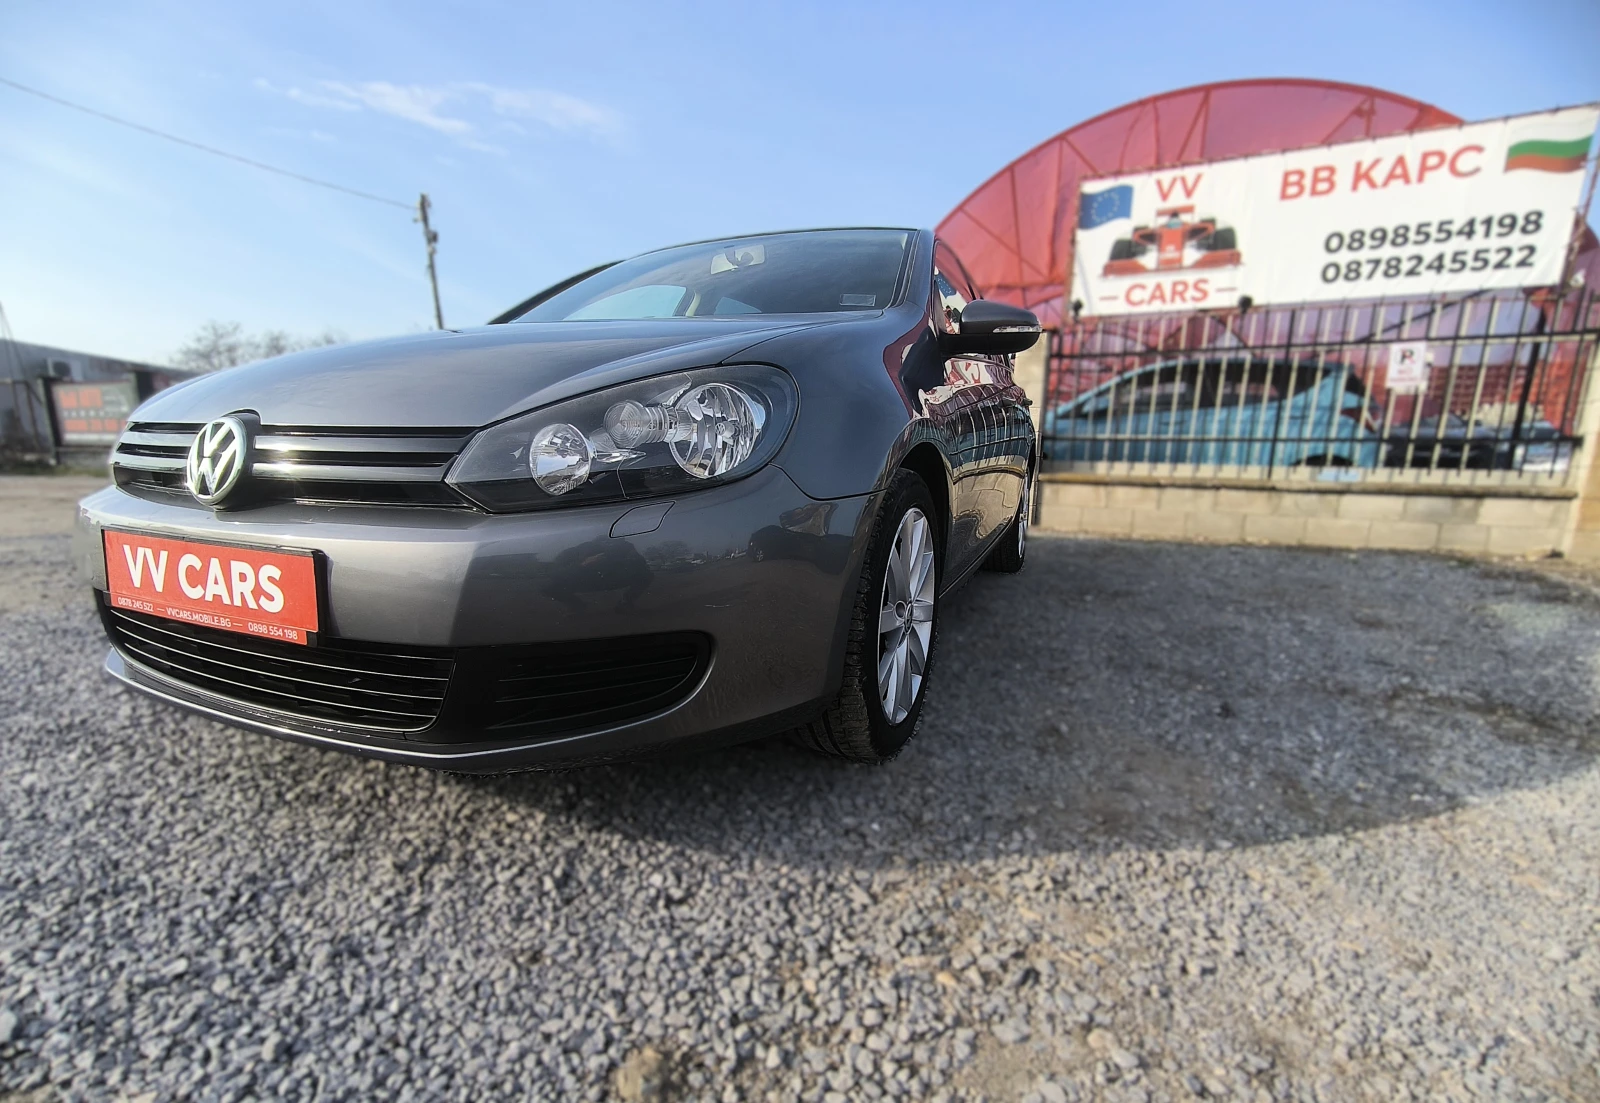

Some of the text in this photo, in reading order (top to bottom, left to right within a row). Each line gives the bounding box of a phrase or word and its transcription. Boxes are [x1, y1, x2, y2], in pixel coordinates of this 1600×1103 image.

[1156, 173, 1204, 202] VV
[1279, 144, 1486, 202] ВВ КАРС
[1324, 210, 1544, 254] 0898554198
[1321, 244, 1537, 284] 0878245522
[1125, 279, 1210, 308] CARS
[123, 544, 284, 613] VV CARS
[117, 597, 154, 612] 0878 245 522
[166, 607, 231, 627] VVCARS.MOBILE.BG
[248, 622, 298, 640] 0898 554 198
